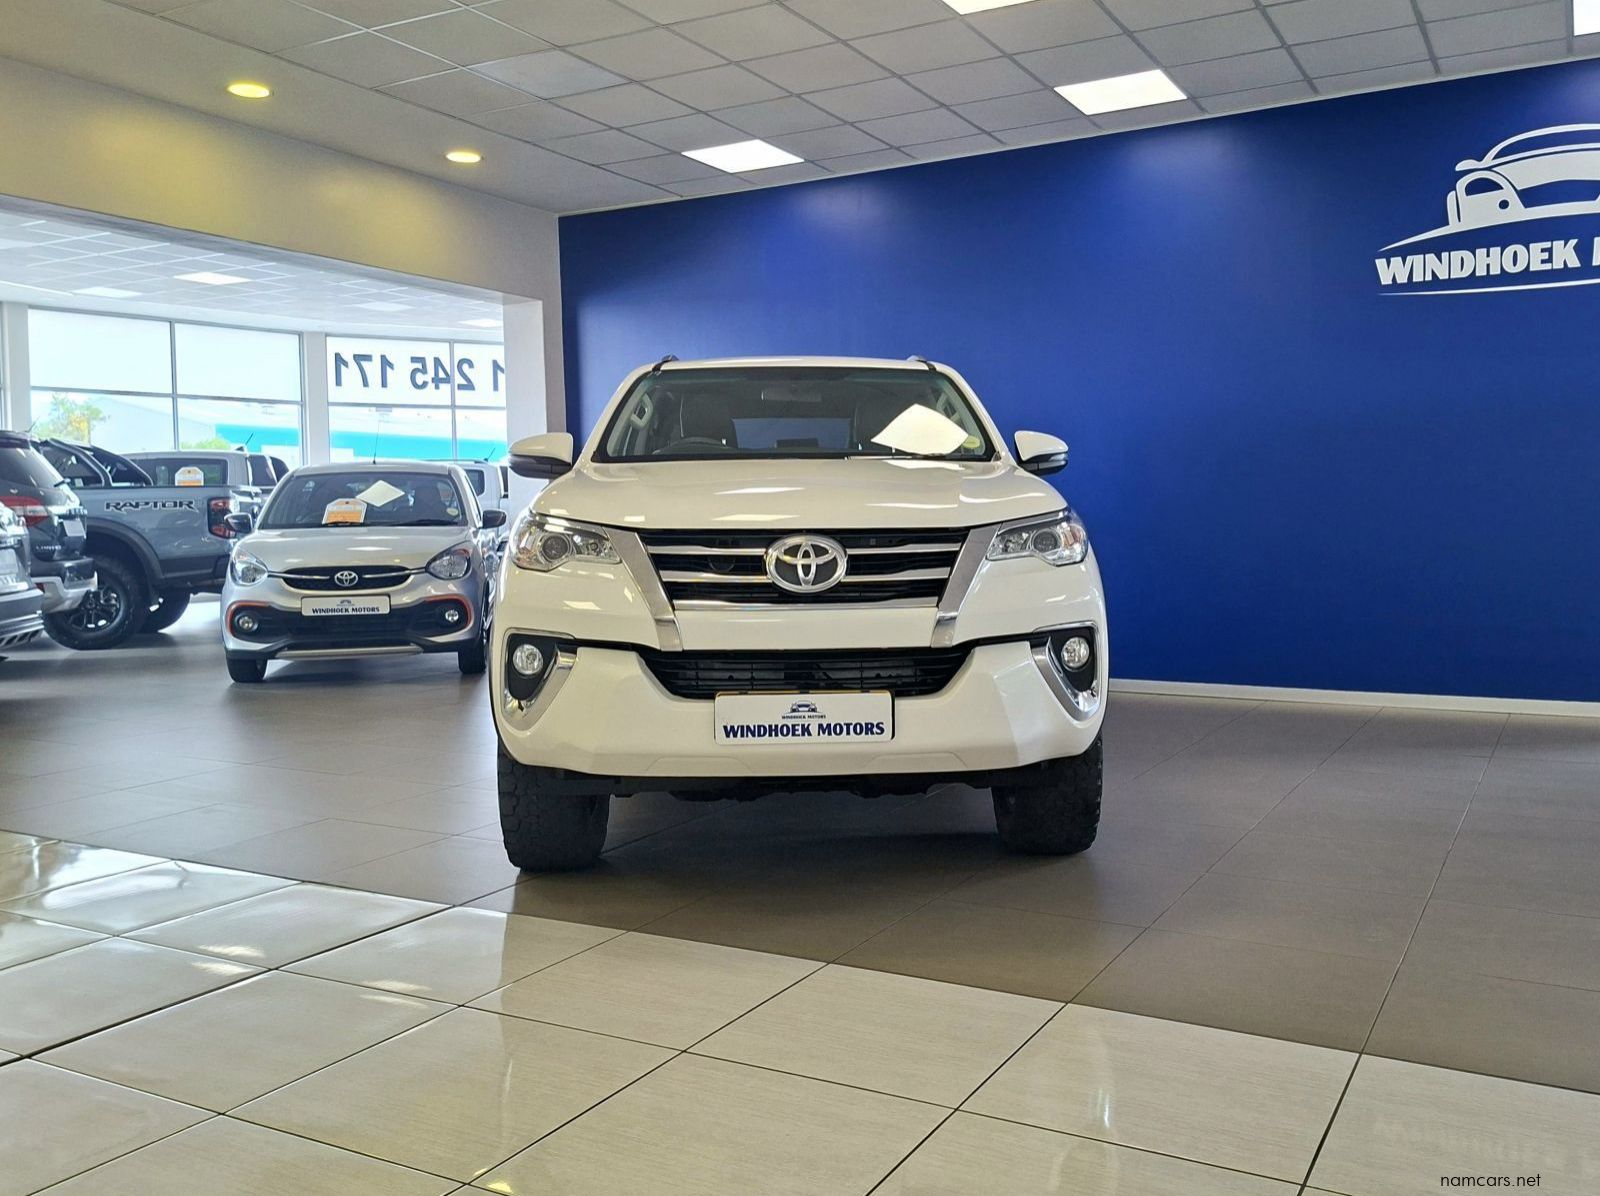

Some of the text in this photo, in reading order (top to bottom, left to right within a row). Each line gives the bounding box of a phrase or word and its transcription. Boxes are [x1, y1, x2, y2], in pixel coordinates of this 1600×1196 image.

[1375, 238, 1582, 286] WINDHOEK
[104, 500, 199, 514] RAPTOR
[722, 721, 885, 739] WINDHOEK MOTORS
